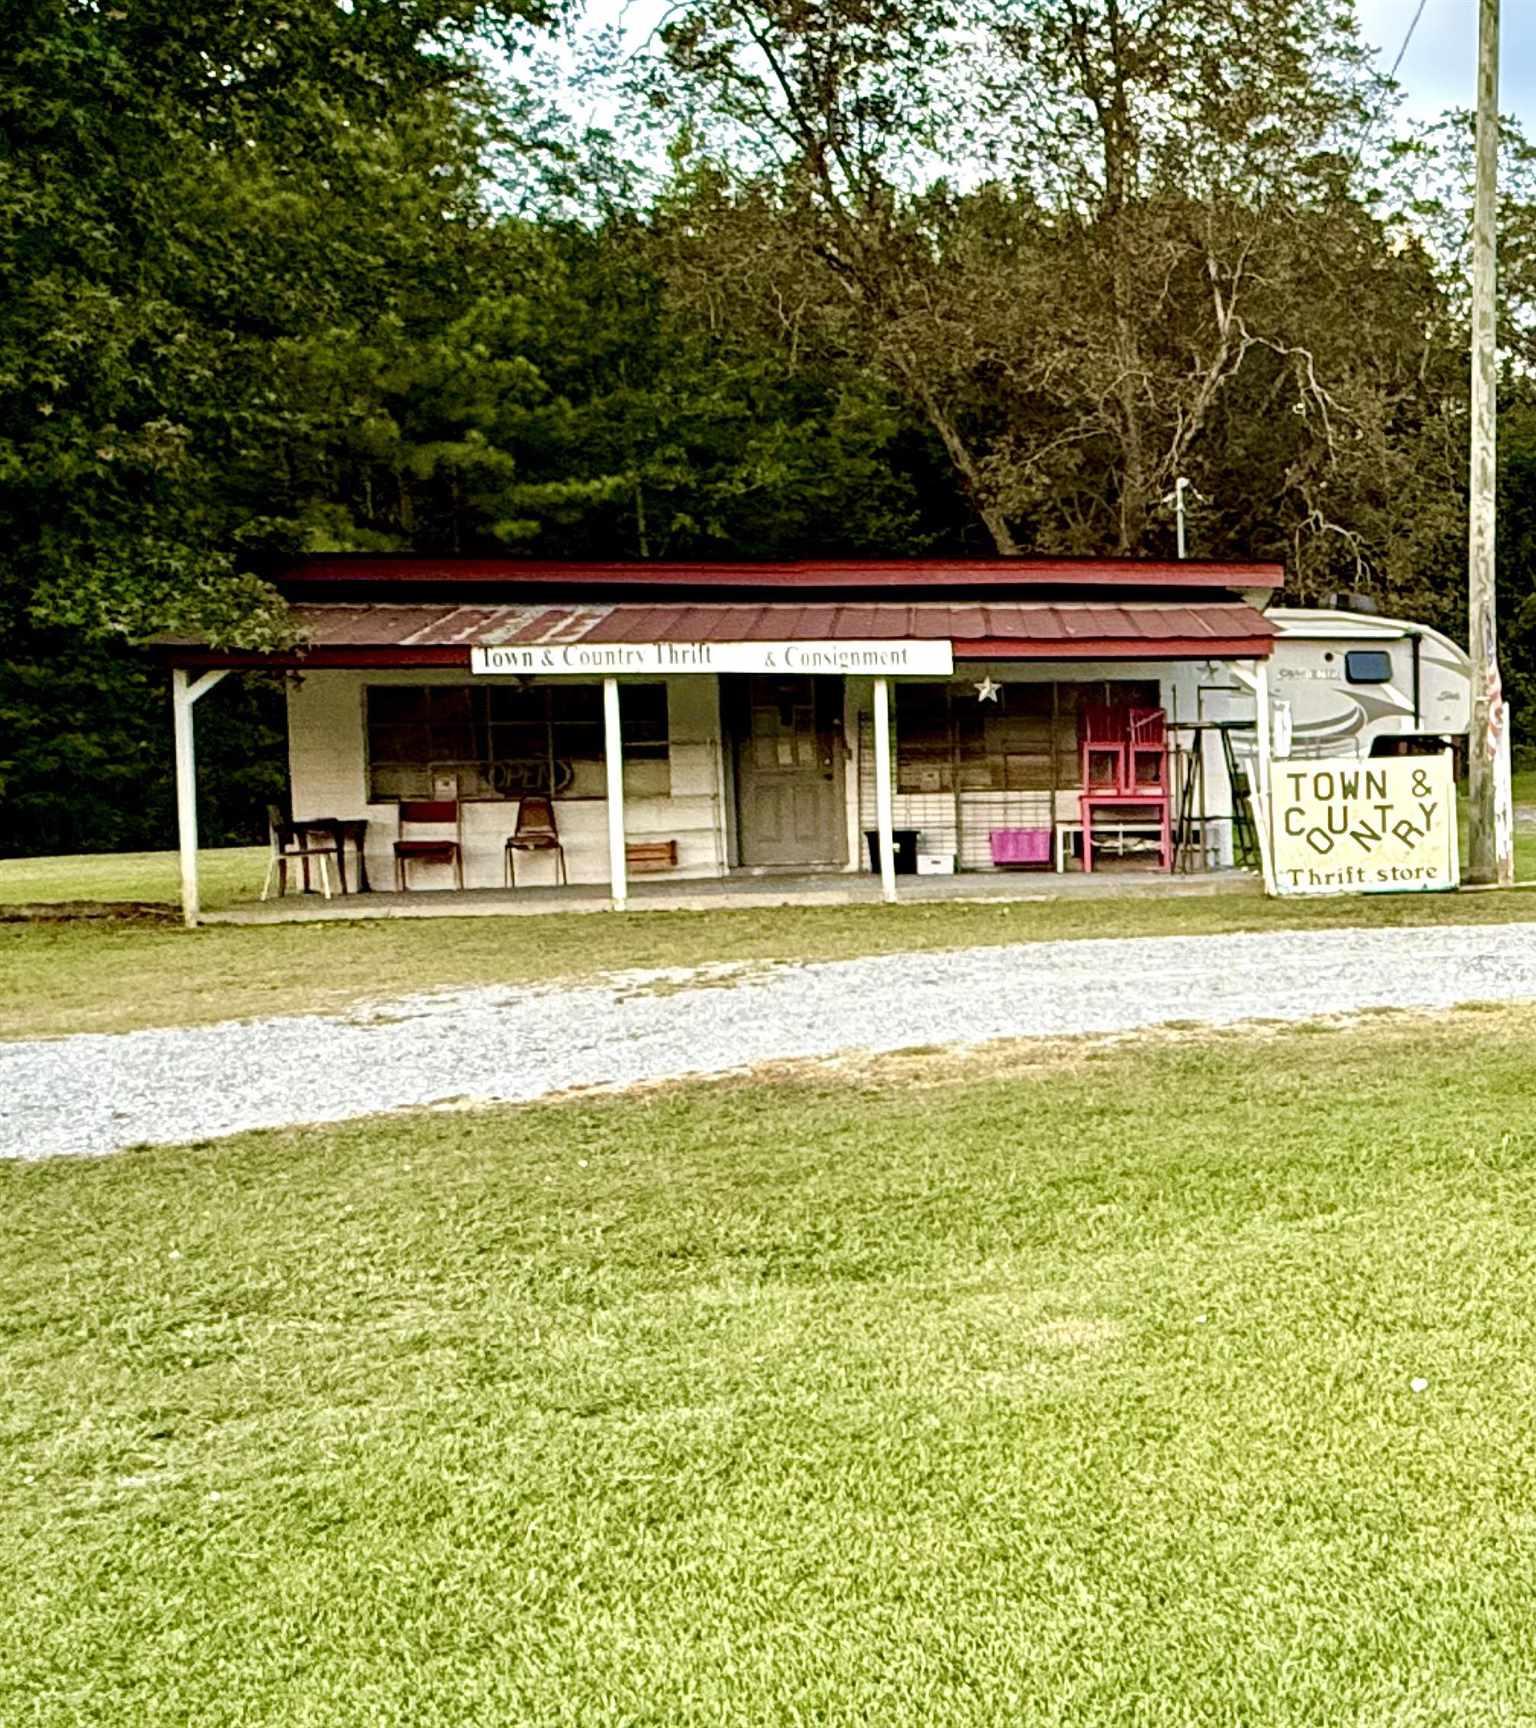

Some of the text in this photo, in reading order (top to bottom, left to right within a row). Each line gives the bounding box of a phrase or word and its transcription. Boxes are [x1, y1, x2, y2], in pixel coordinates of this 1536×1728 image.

[480, 642, 712, 668] Town & Country Thrift
[764, 645, 909, 668] & Consignment
[1286, 768, 1433, 802] TOWN &
[1284, 802, 1438, 855] COUNTRY
[1287, 865, 1438, 887] Thrift store
